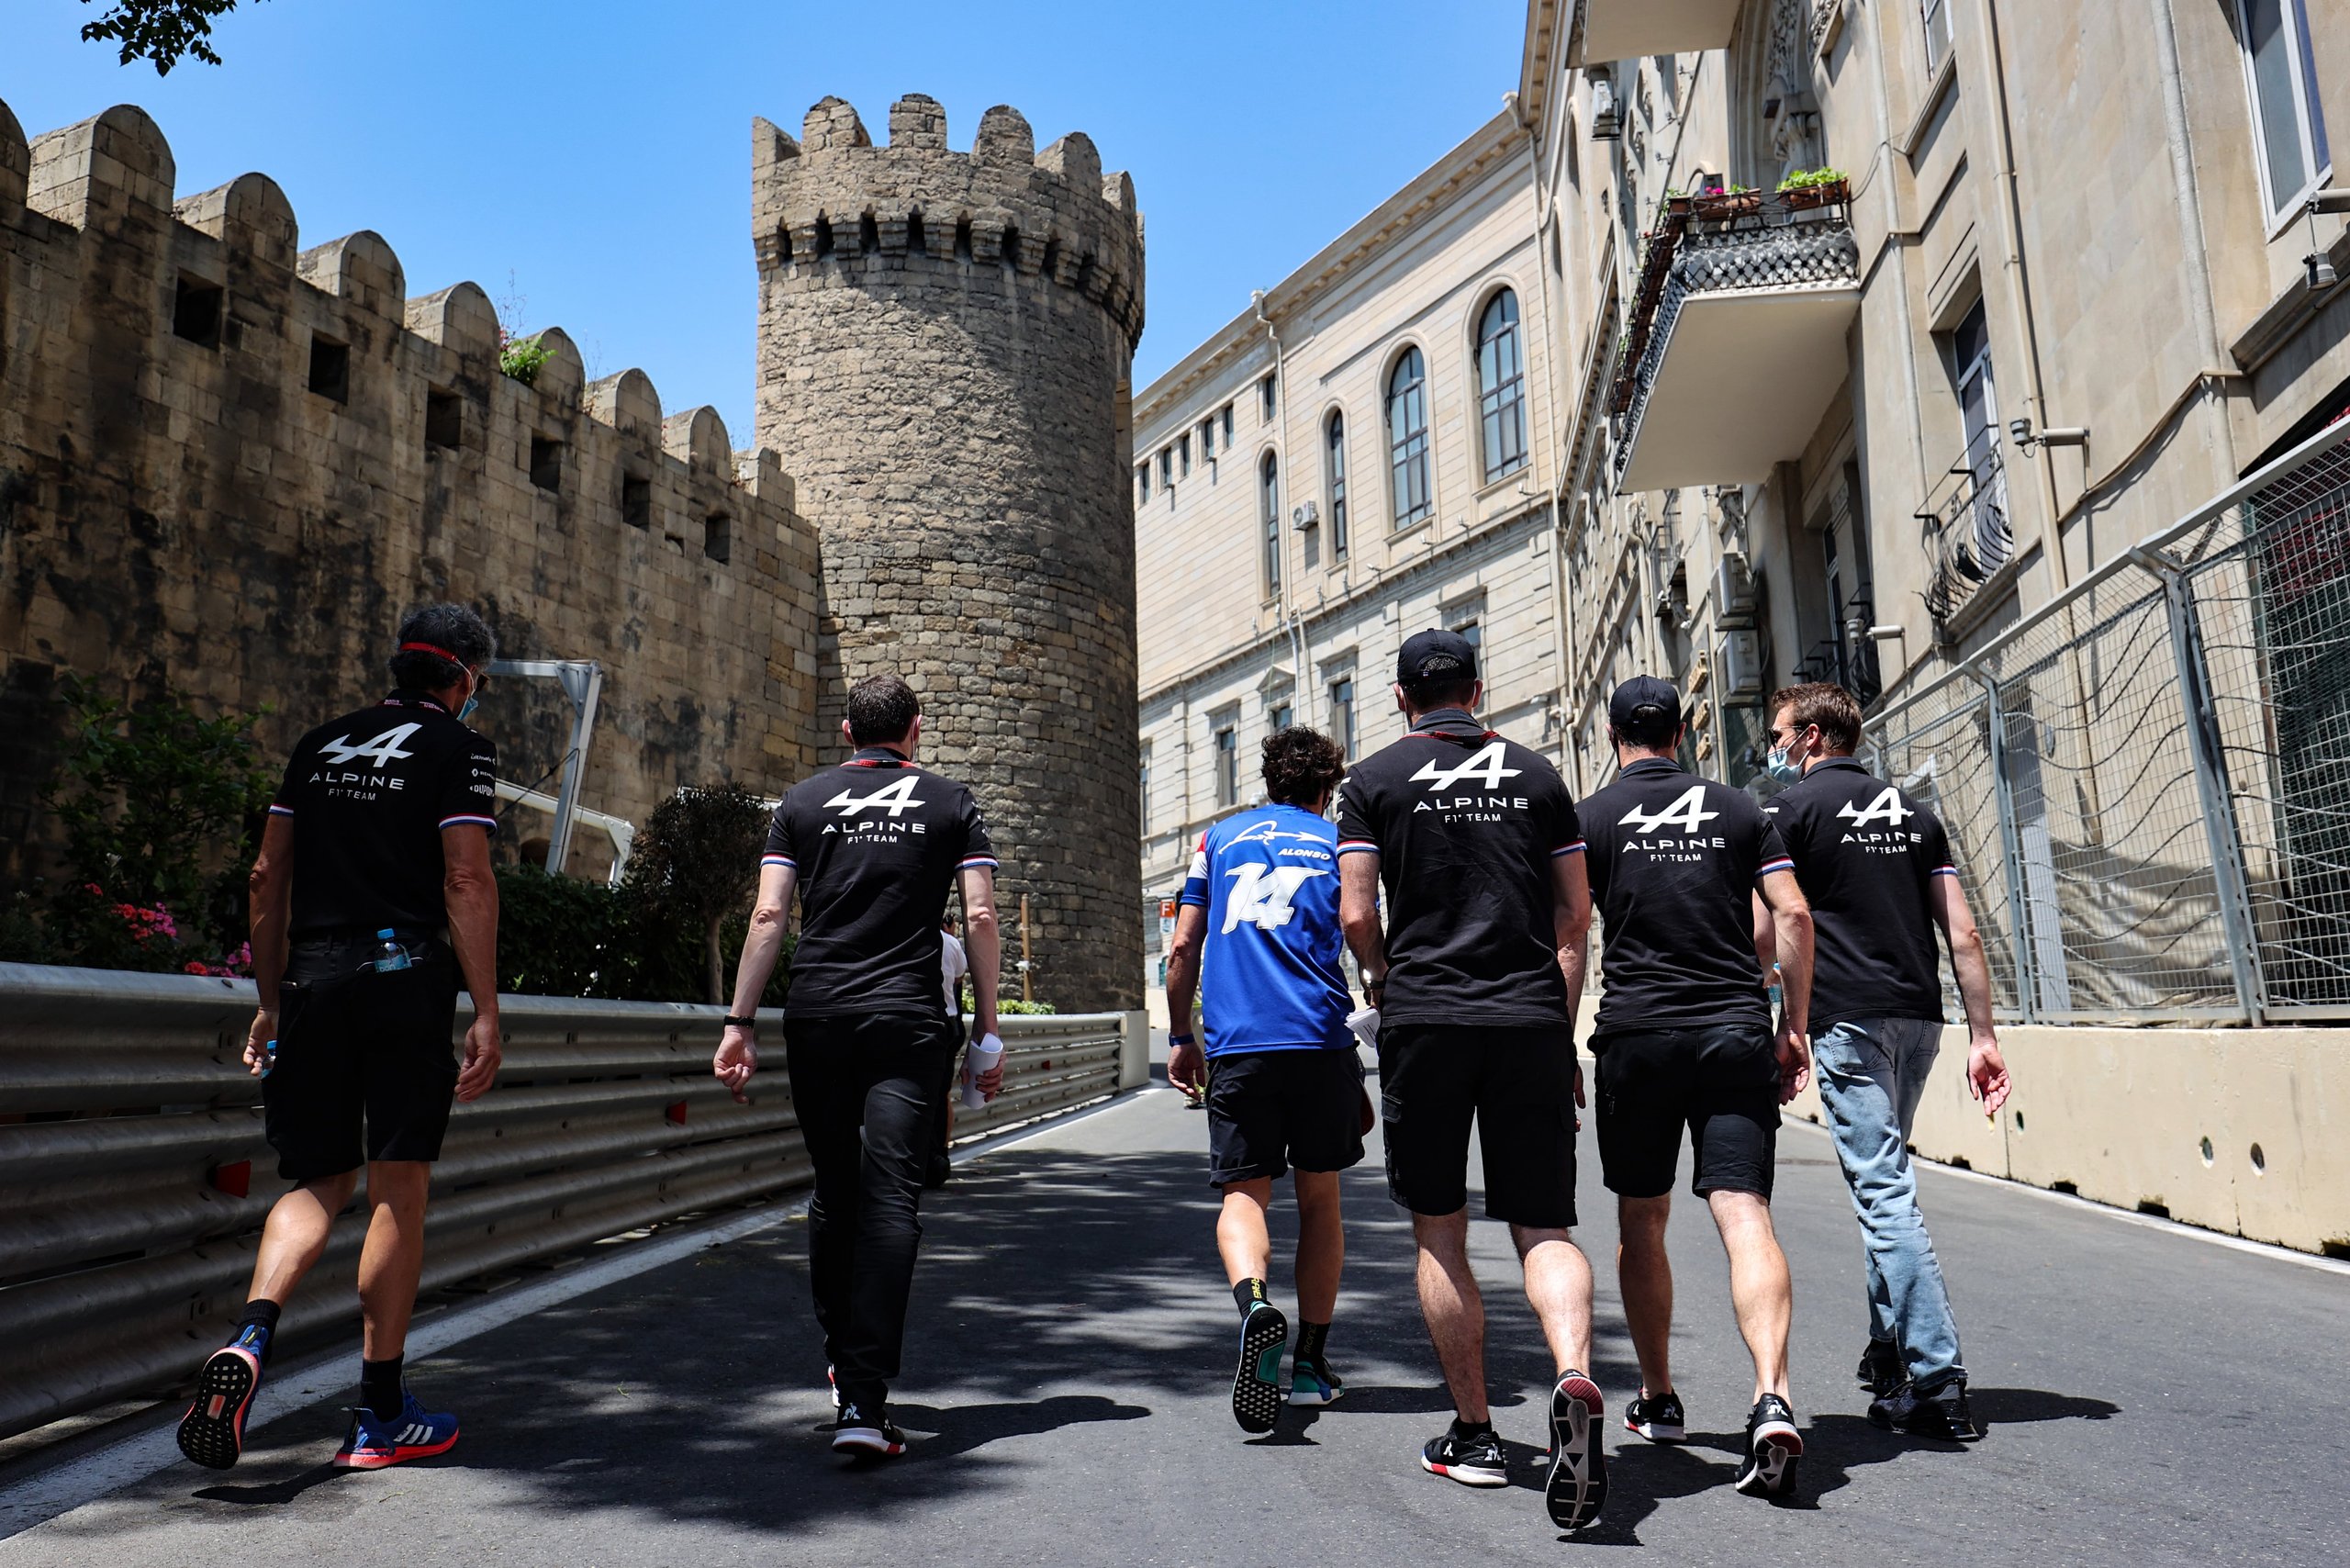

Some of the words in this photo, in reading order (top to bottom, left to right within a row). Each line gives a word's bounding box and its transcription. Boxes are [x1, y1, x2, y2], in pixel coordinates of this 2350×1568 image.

[308, 771, 405, 790] ALPINE
[346, 790, 376, 801] TEAM
[1413, 797, 1528, 813] ALPINE
[1466, 813, 1502, 823] TEAM
[821, 821, 926, 835] ALPINE
[867, 834, 898, 844] TEAM
[1841, 831, 1922, 844] ALPINE
[1622, 836, 1726, 854] ALPINE
[1879, 845, 1908, 855] TEAM
[1277, 847, 1331, 861] ALONSO
[1670, 853, 1702, 862] TEAM
[1221, 862, 1329, 935] 14
